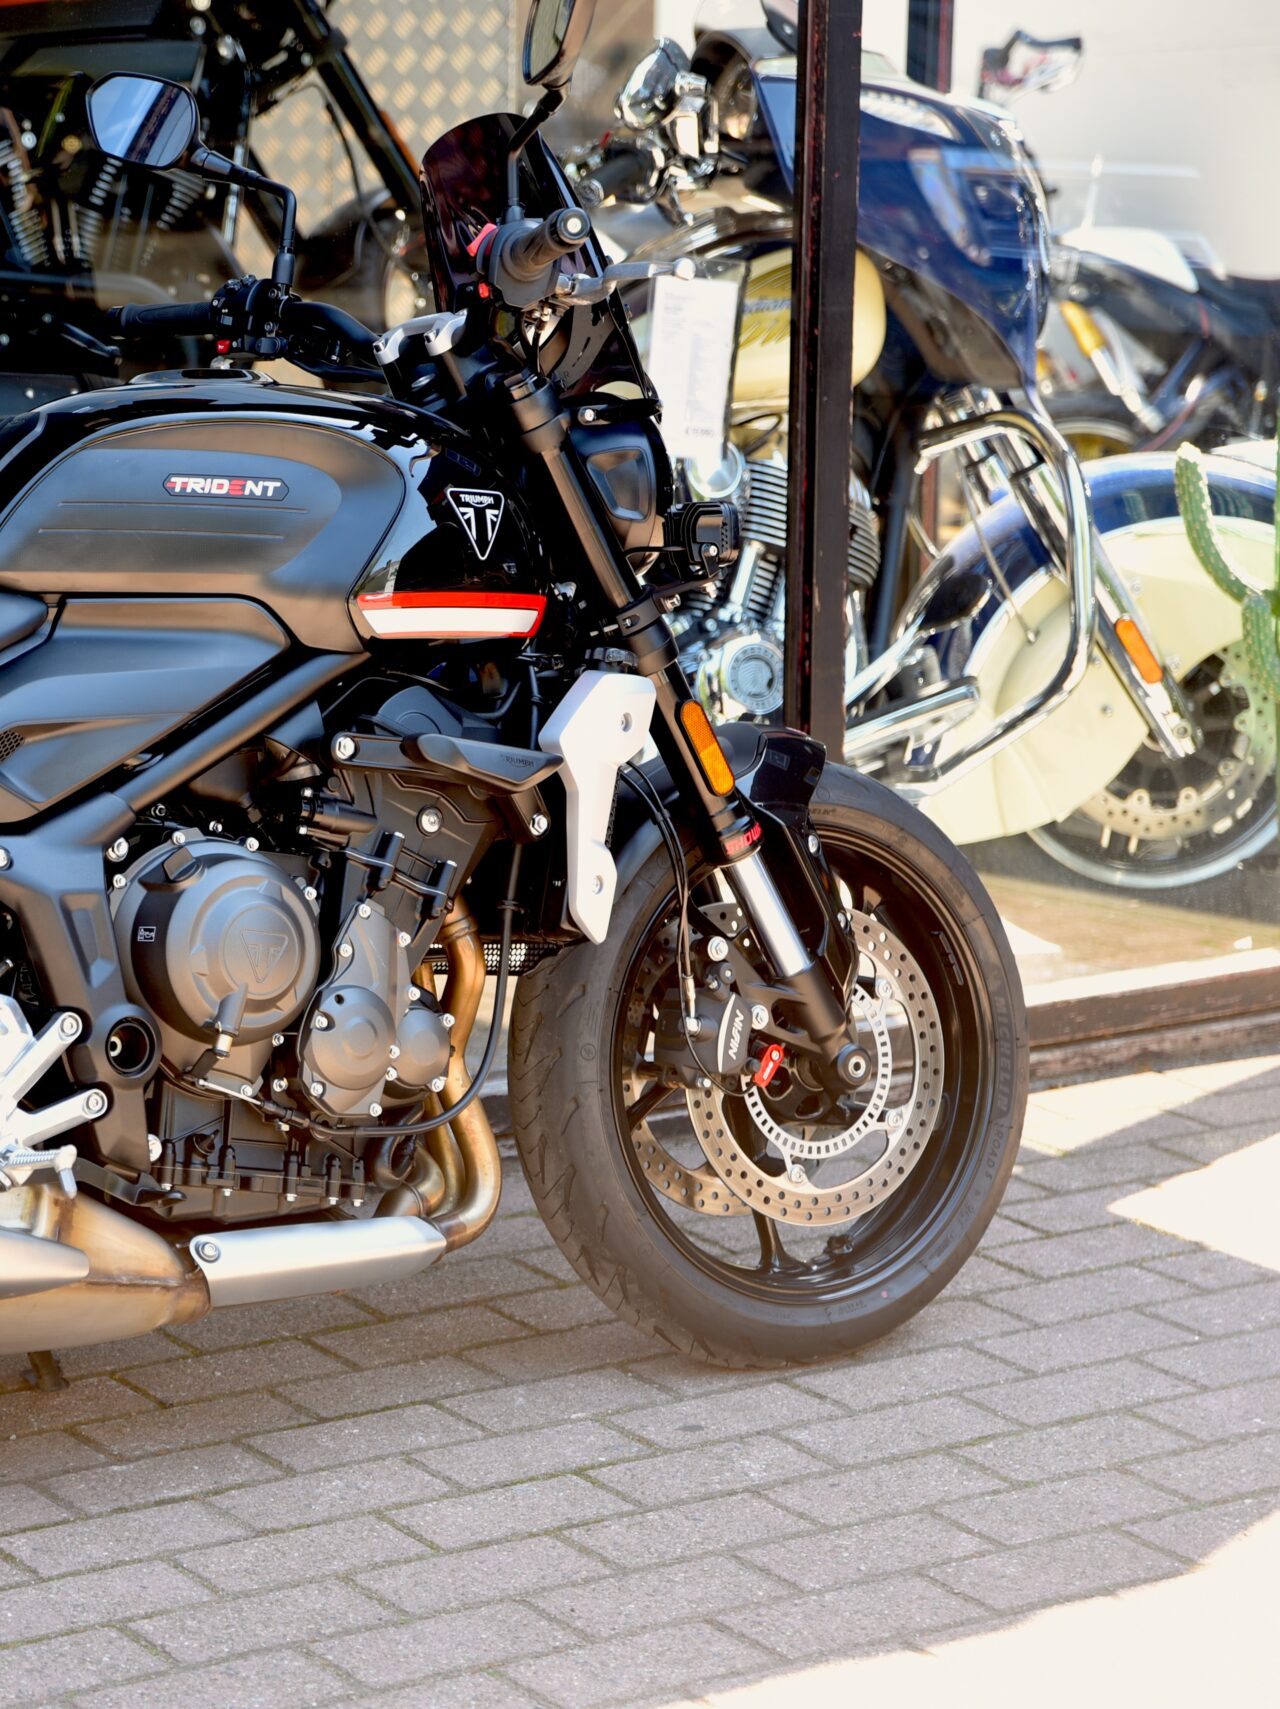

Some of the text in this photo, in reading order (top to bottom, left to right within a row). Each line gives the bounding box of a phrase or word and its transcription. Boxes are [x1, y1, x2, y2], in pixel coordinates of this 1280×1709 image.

[166, 477, 281, 496] TRIDENT
[459, 494, 494, 504] TRIUMPH
[724, 822, 762, 856] SHOW
[994, 996, 1011, 1112] MICHELIN
